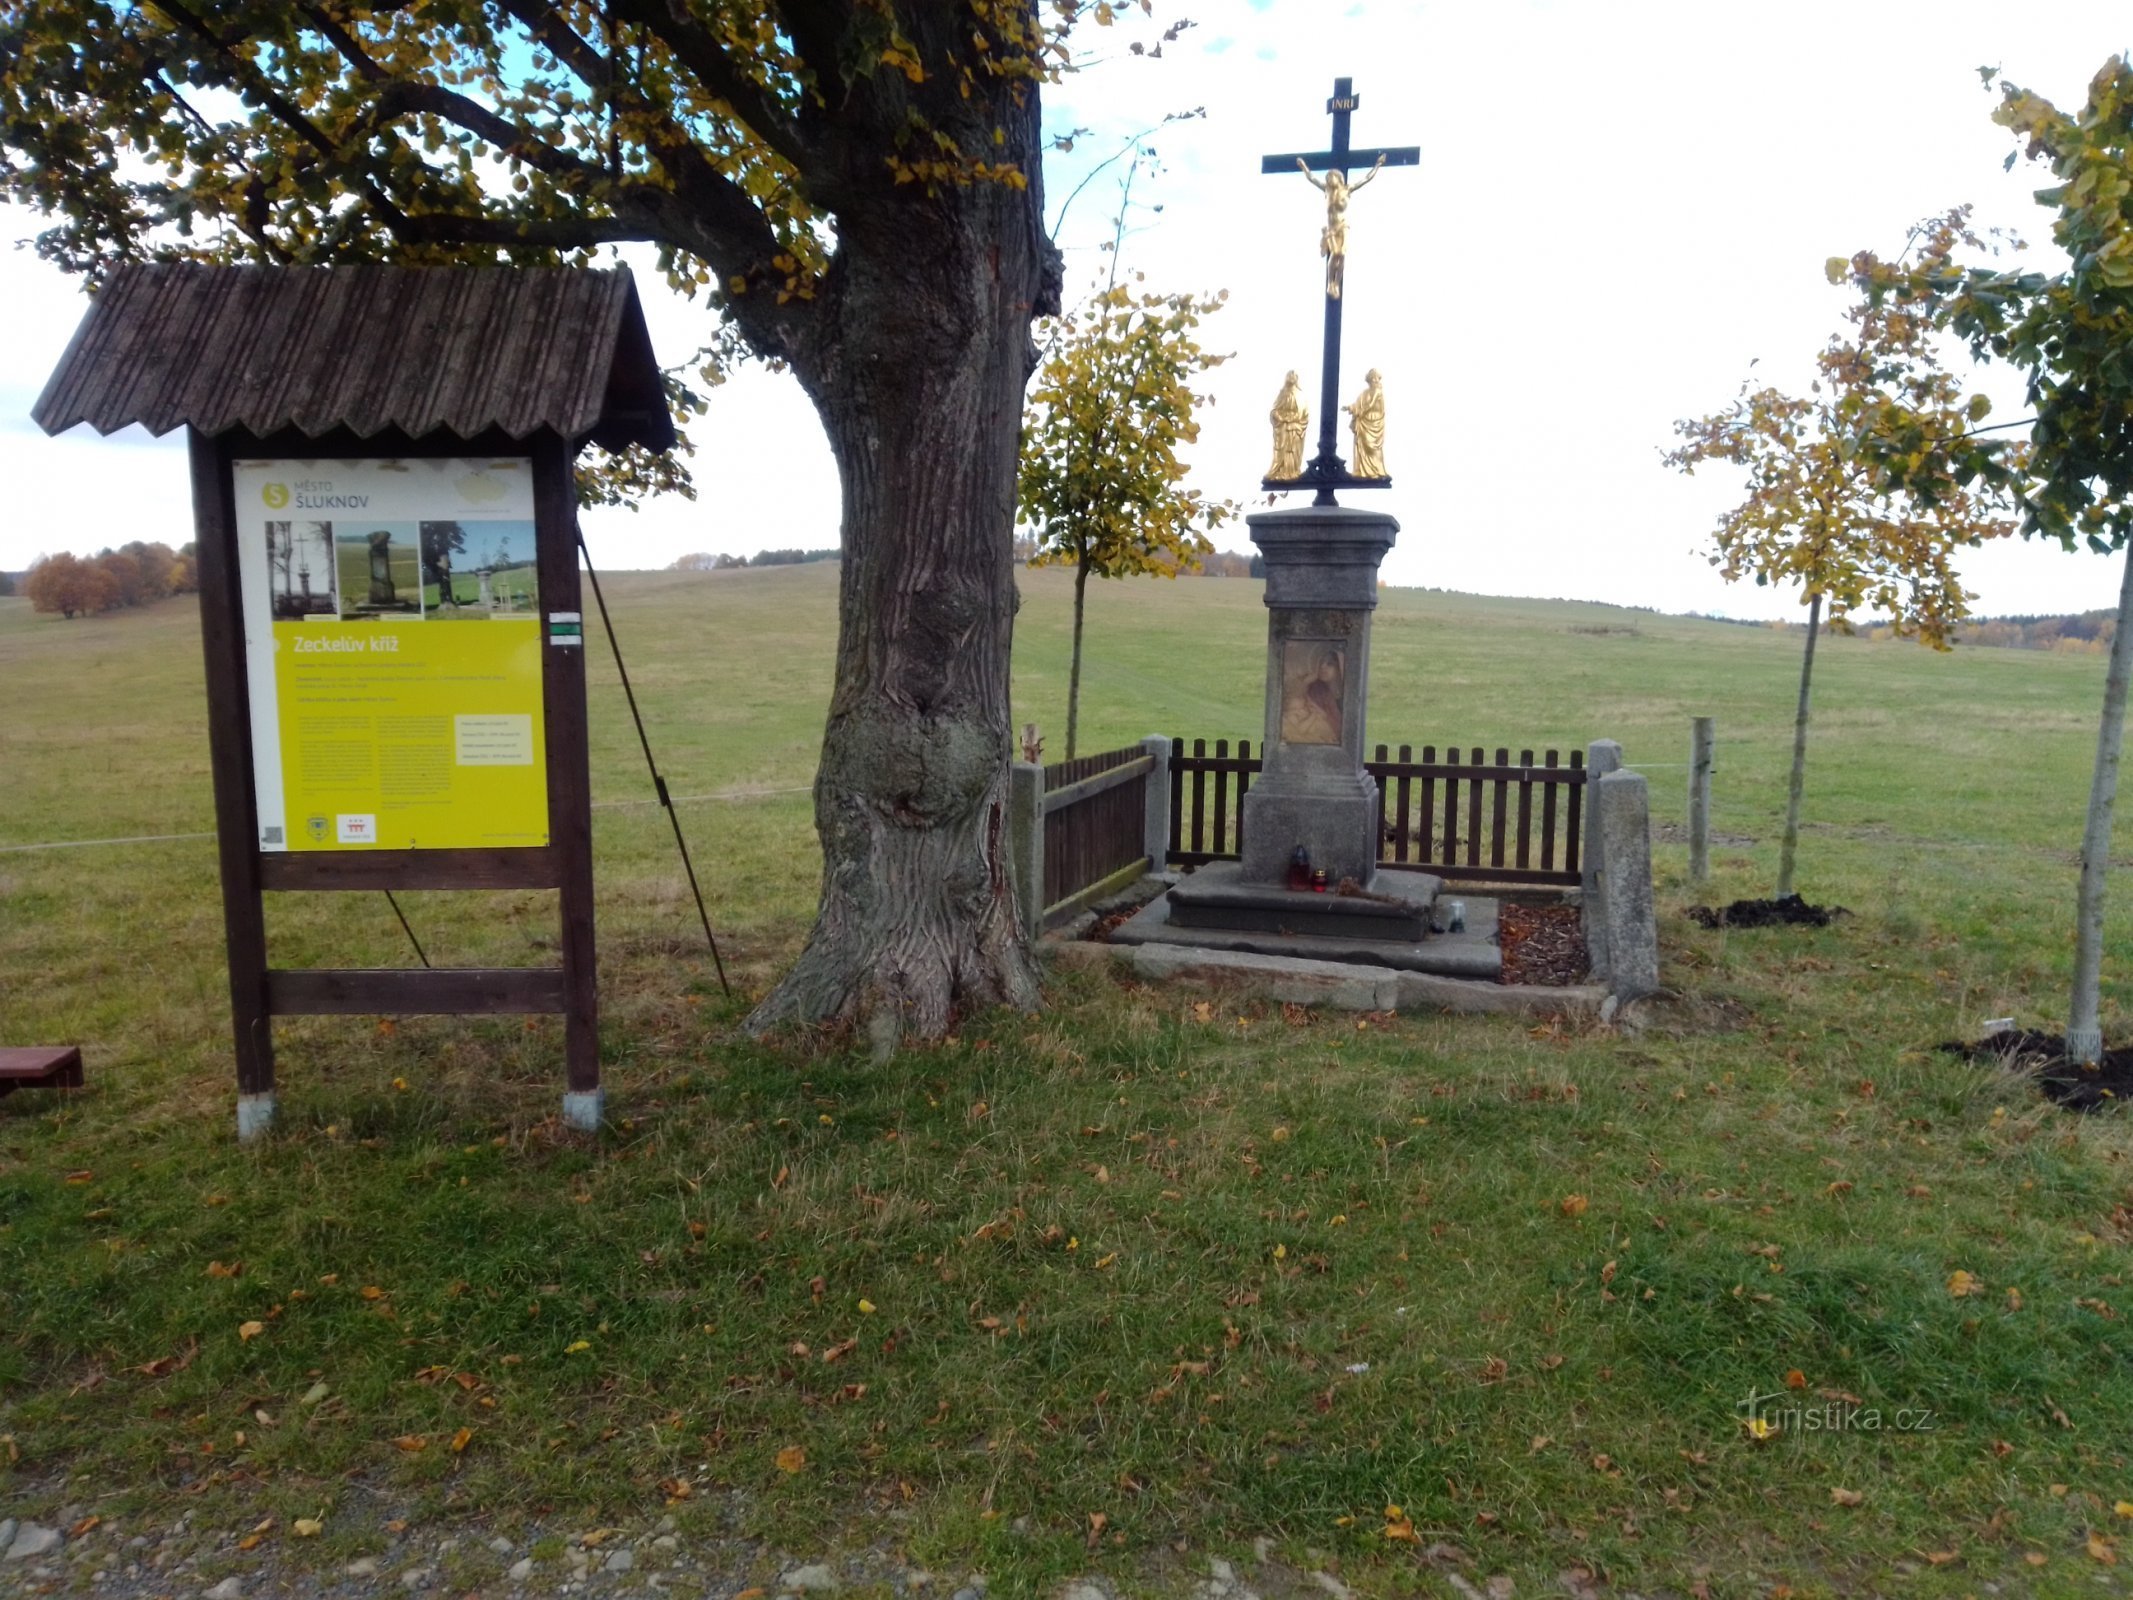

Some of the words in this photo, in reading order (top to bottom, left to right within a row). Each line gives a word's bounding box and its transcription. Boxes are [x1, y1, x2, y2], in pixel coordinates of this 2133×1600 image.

[1332, 98, 1354, 110] INRI
[294, 479, 333, 492] MĚSTO
[295, 492, 369, 509] ŠLUKNOV
[293, 636, 365, 653] Zeckelův
[369, 635, 399, 653] kříž
